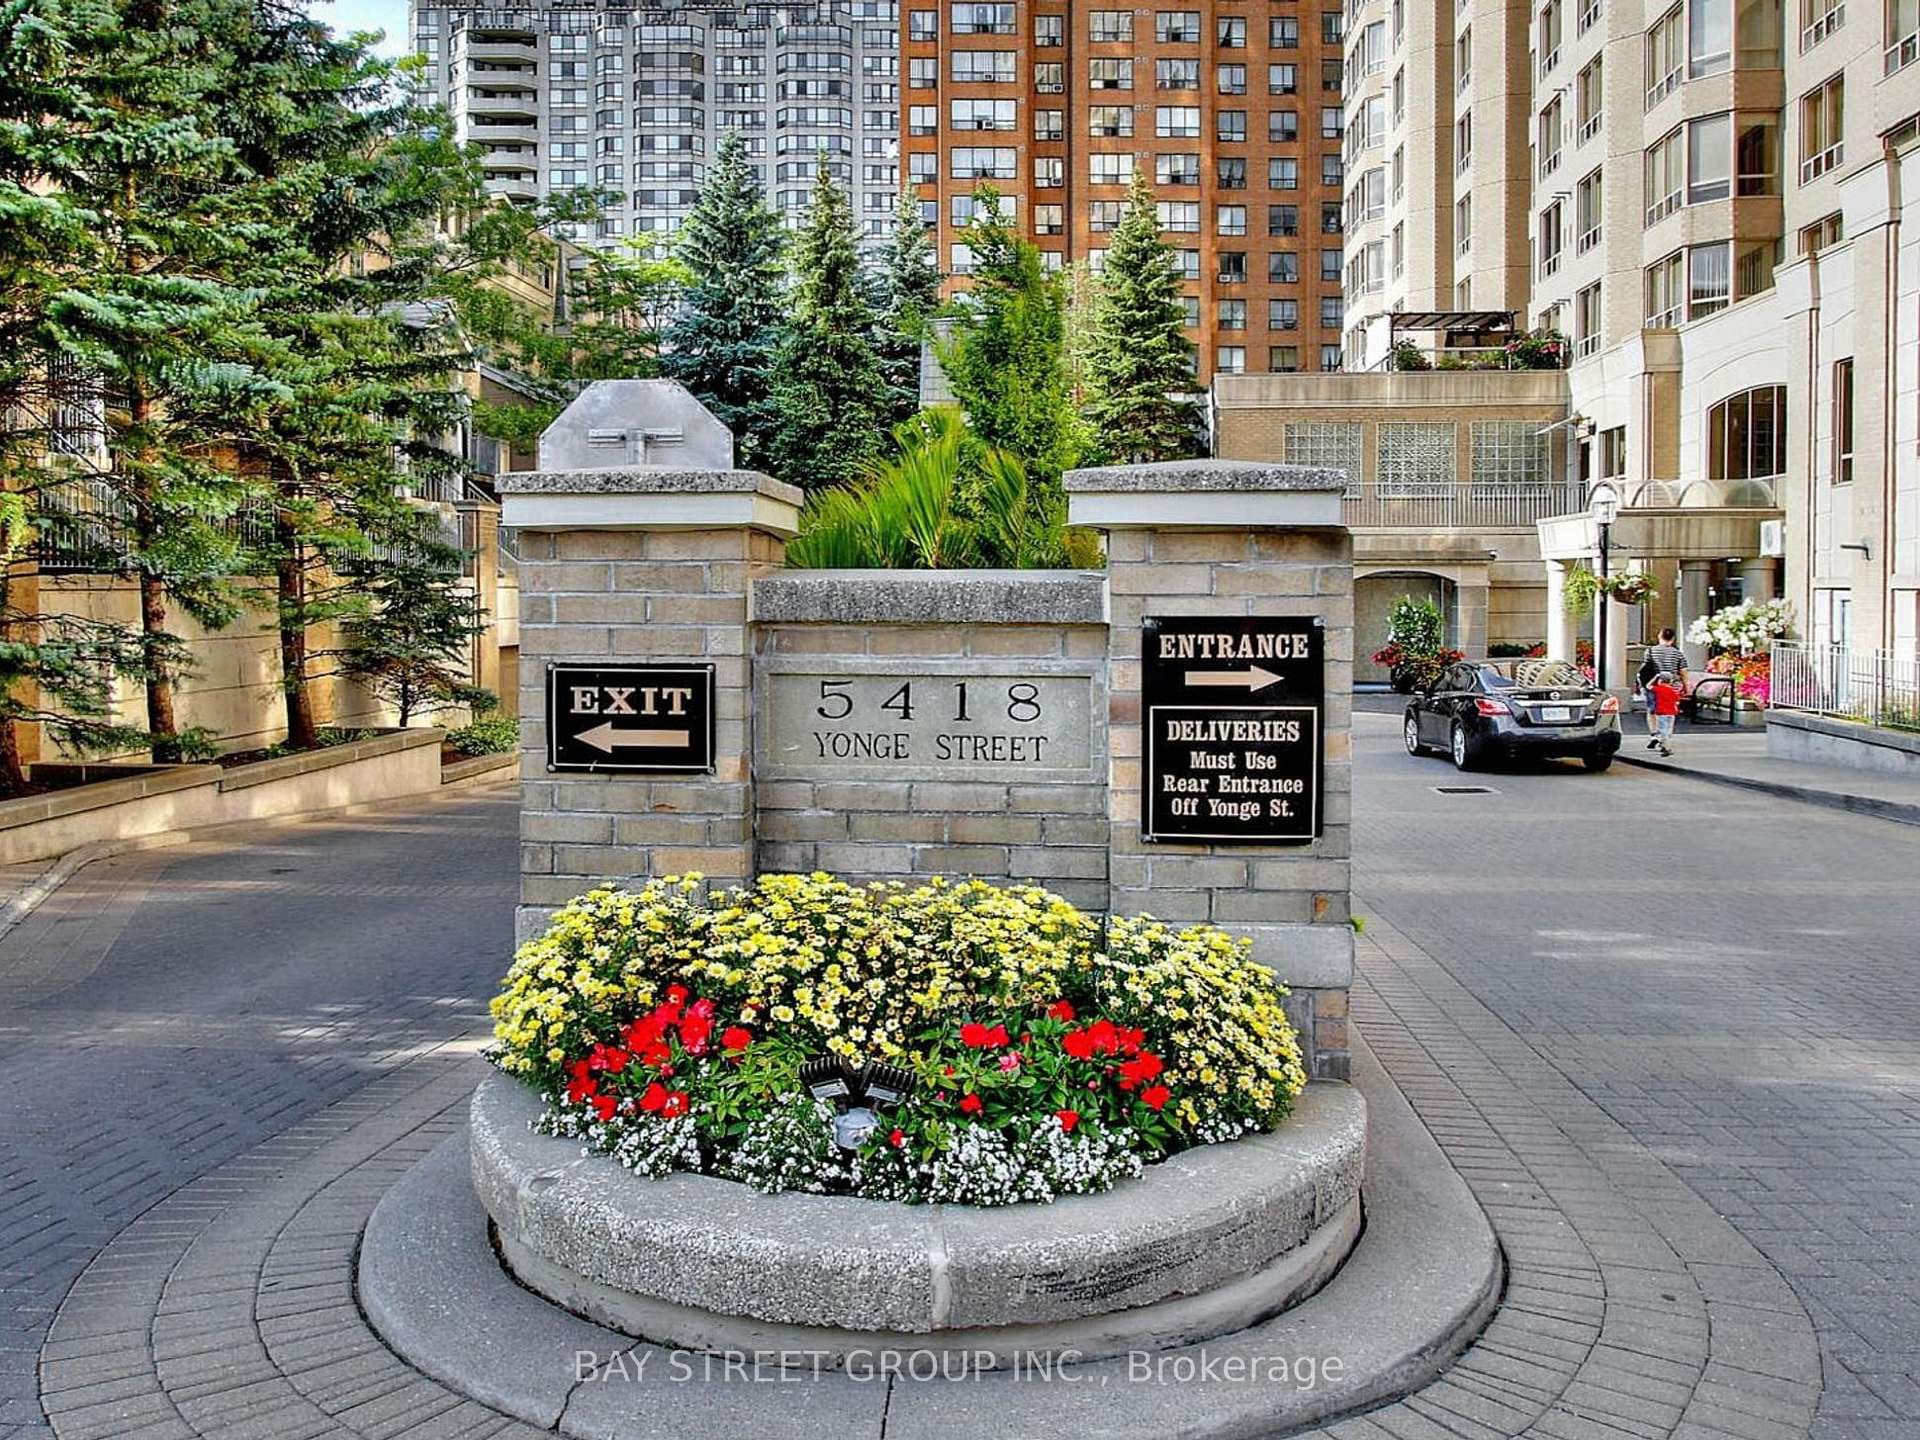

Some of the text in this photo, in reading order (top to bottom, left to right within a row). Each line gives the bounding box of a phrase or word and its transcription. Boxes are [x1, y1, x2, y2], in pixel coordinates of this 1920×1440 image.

[1158, 633, 1310, 659] ENTRANCE
[569, 686, 693, 716] EXIT
[816, 680, 1042, 723] 5418
[1166, 720, 1301, 742] DELIVERIES
[812, 732, 1049, 762] YONGE STREET
[1189, 751, 1278, 770] Must Use
[1163, 774, 1304, 794] Rear Entrance
[1171, 798, 1295, 821] Off Yonge St.
